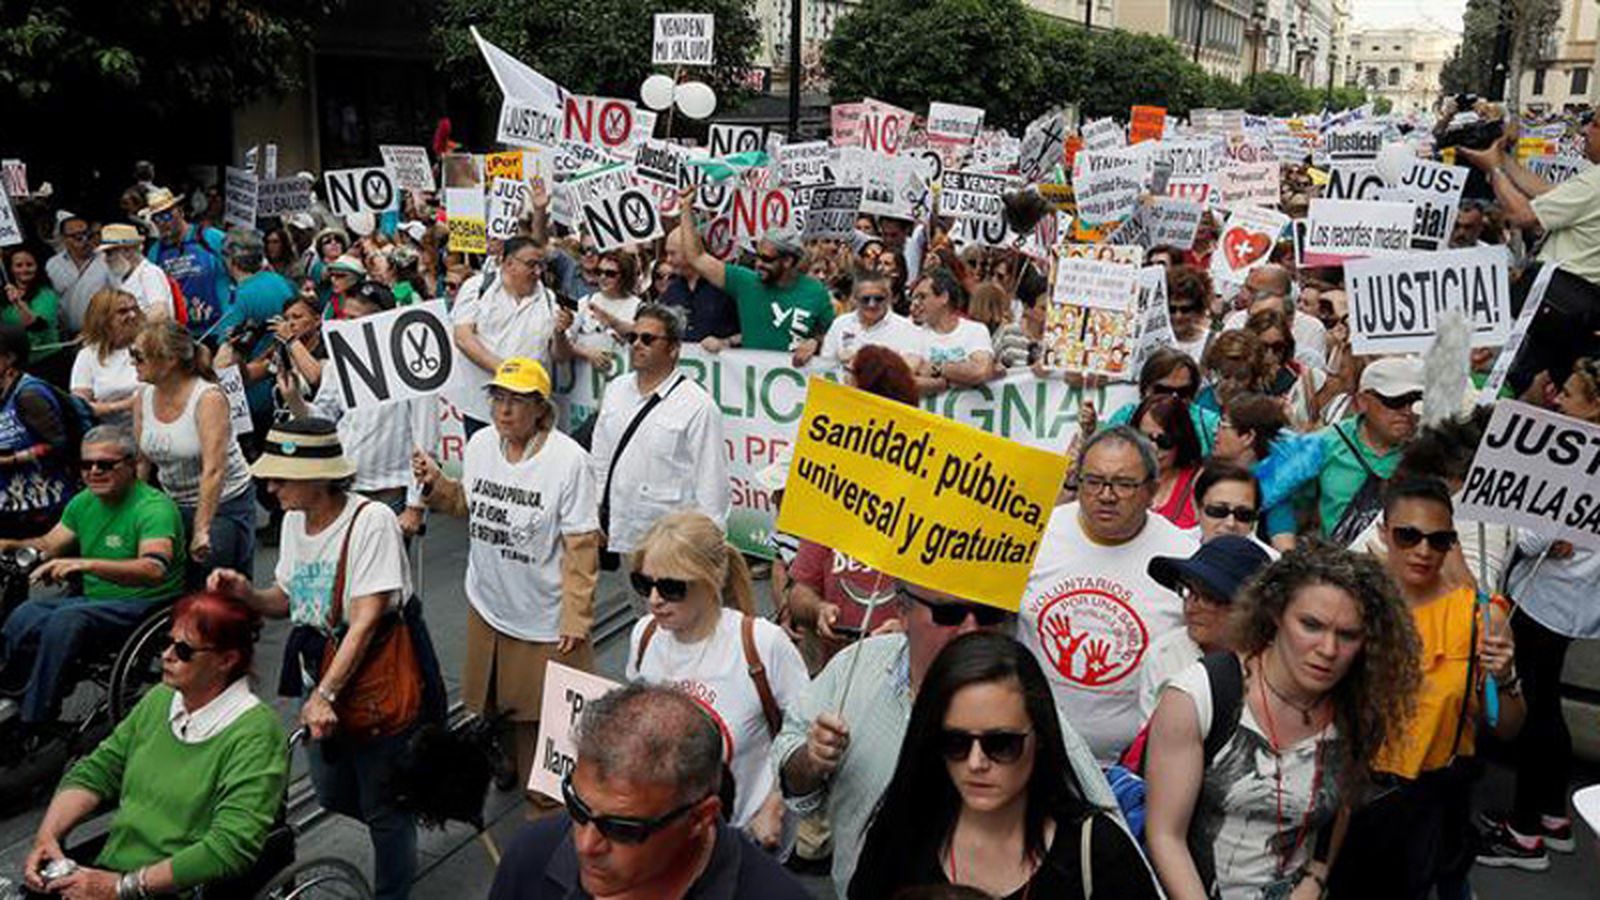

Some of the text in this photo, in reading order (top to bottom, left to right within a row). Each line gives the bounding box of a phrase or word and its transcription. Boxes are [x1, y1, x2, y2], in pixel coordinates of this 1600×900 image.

[660, 17, 705, 37] VENDEN
[565, 97, 632, 146] NO
[328, 170, 394, 211] NO
[583, 191, 656, 248] NO
[1353, 264, 1500, 333] ¡JUSTICIA!
[328, 308, 453, 409] NO
[798, 455, 1037, 565] universal y gratuita!
[934, 451, 1045, 532] pública,
[1461, 466, 1530, 511] PARA
[1526, 480, 1569, 521] LA
[1029, 577, 1134, 614] VOLUNTARIOS
